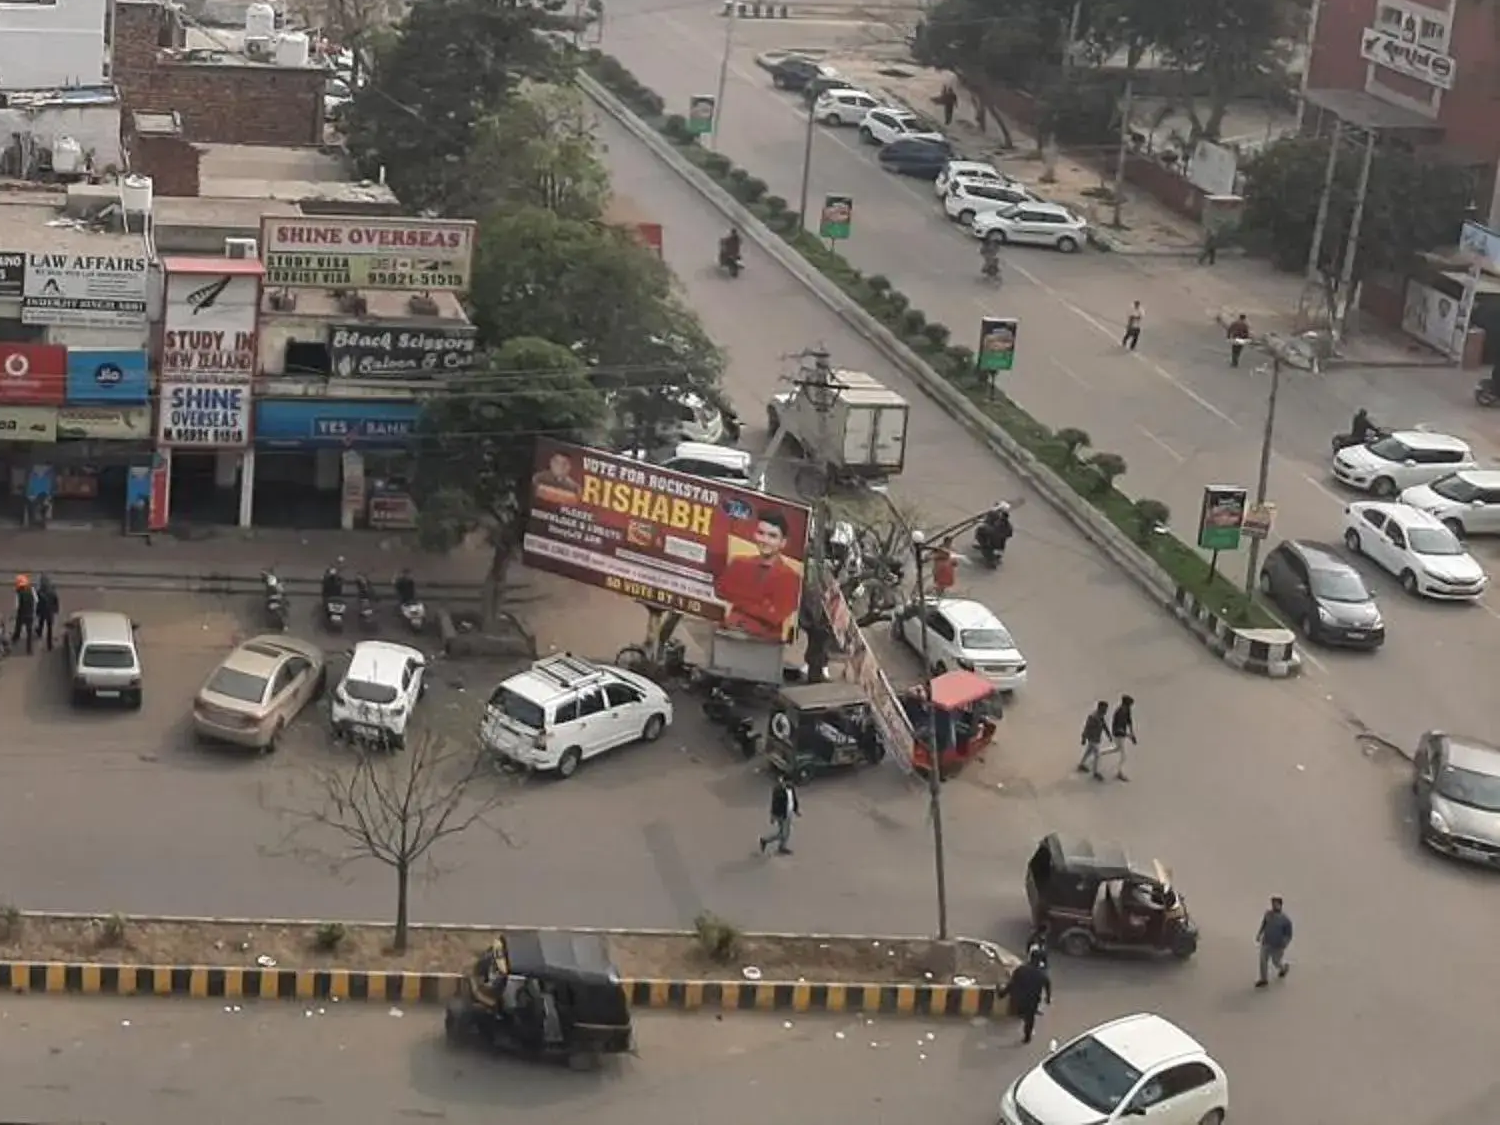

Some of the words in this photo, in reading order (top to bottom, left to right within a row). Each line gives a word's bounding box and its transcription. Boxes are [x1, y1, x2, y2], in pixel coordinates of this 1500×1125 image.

[277, 226, 343, 244] SHINE
[348, 228, 460, 248] OVERSEAS
[30, 254, 67, 268] LAW
[73, 257, 145, 272] AFFAIRS
[267, 255, 312, 269] STUDY
[317, 255, 349, 270] VISA
[267, 271, 315, 285] TOURIST
[322, 271, 350, 285] VISA
[166, 330, 224, 351] STUDY
[235, 331, 255, 352] IN
[332, 330, 392, 351] Black
[397, 332, 476, 352] Scissors
[164, 352, 192, 369] NEW
[197, 353, 252, 370] ZEALAND
[97, 368, 120, 381] Jio
[171, 387, 243, 410] SHINE
[171, 410, 237, 427] OVERSEAS
[318, 421, 348, 435] YES
[366, 422, 408, 436] BANK
[583, 457, 617, 478] VOTE
[620, 467, 645, 485] FOR
[649, 472, 719, 505] ROCKSTAR
[582, 475, 714, 536] RISHABH
[623, 580, 654, 600] VOTE
